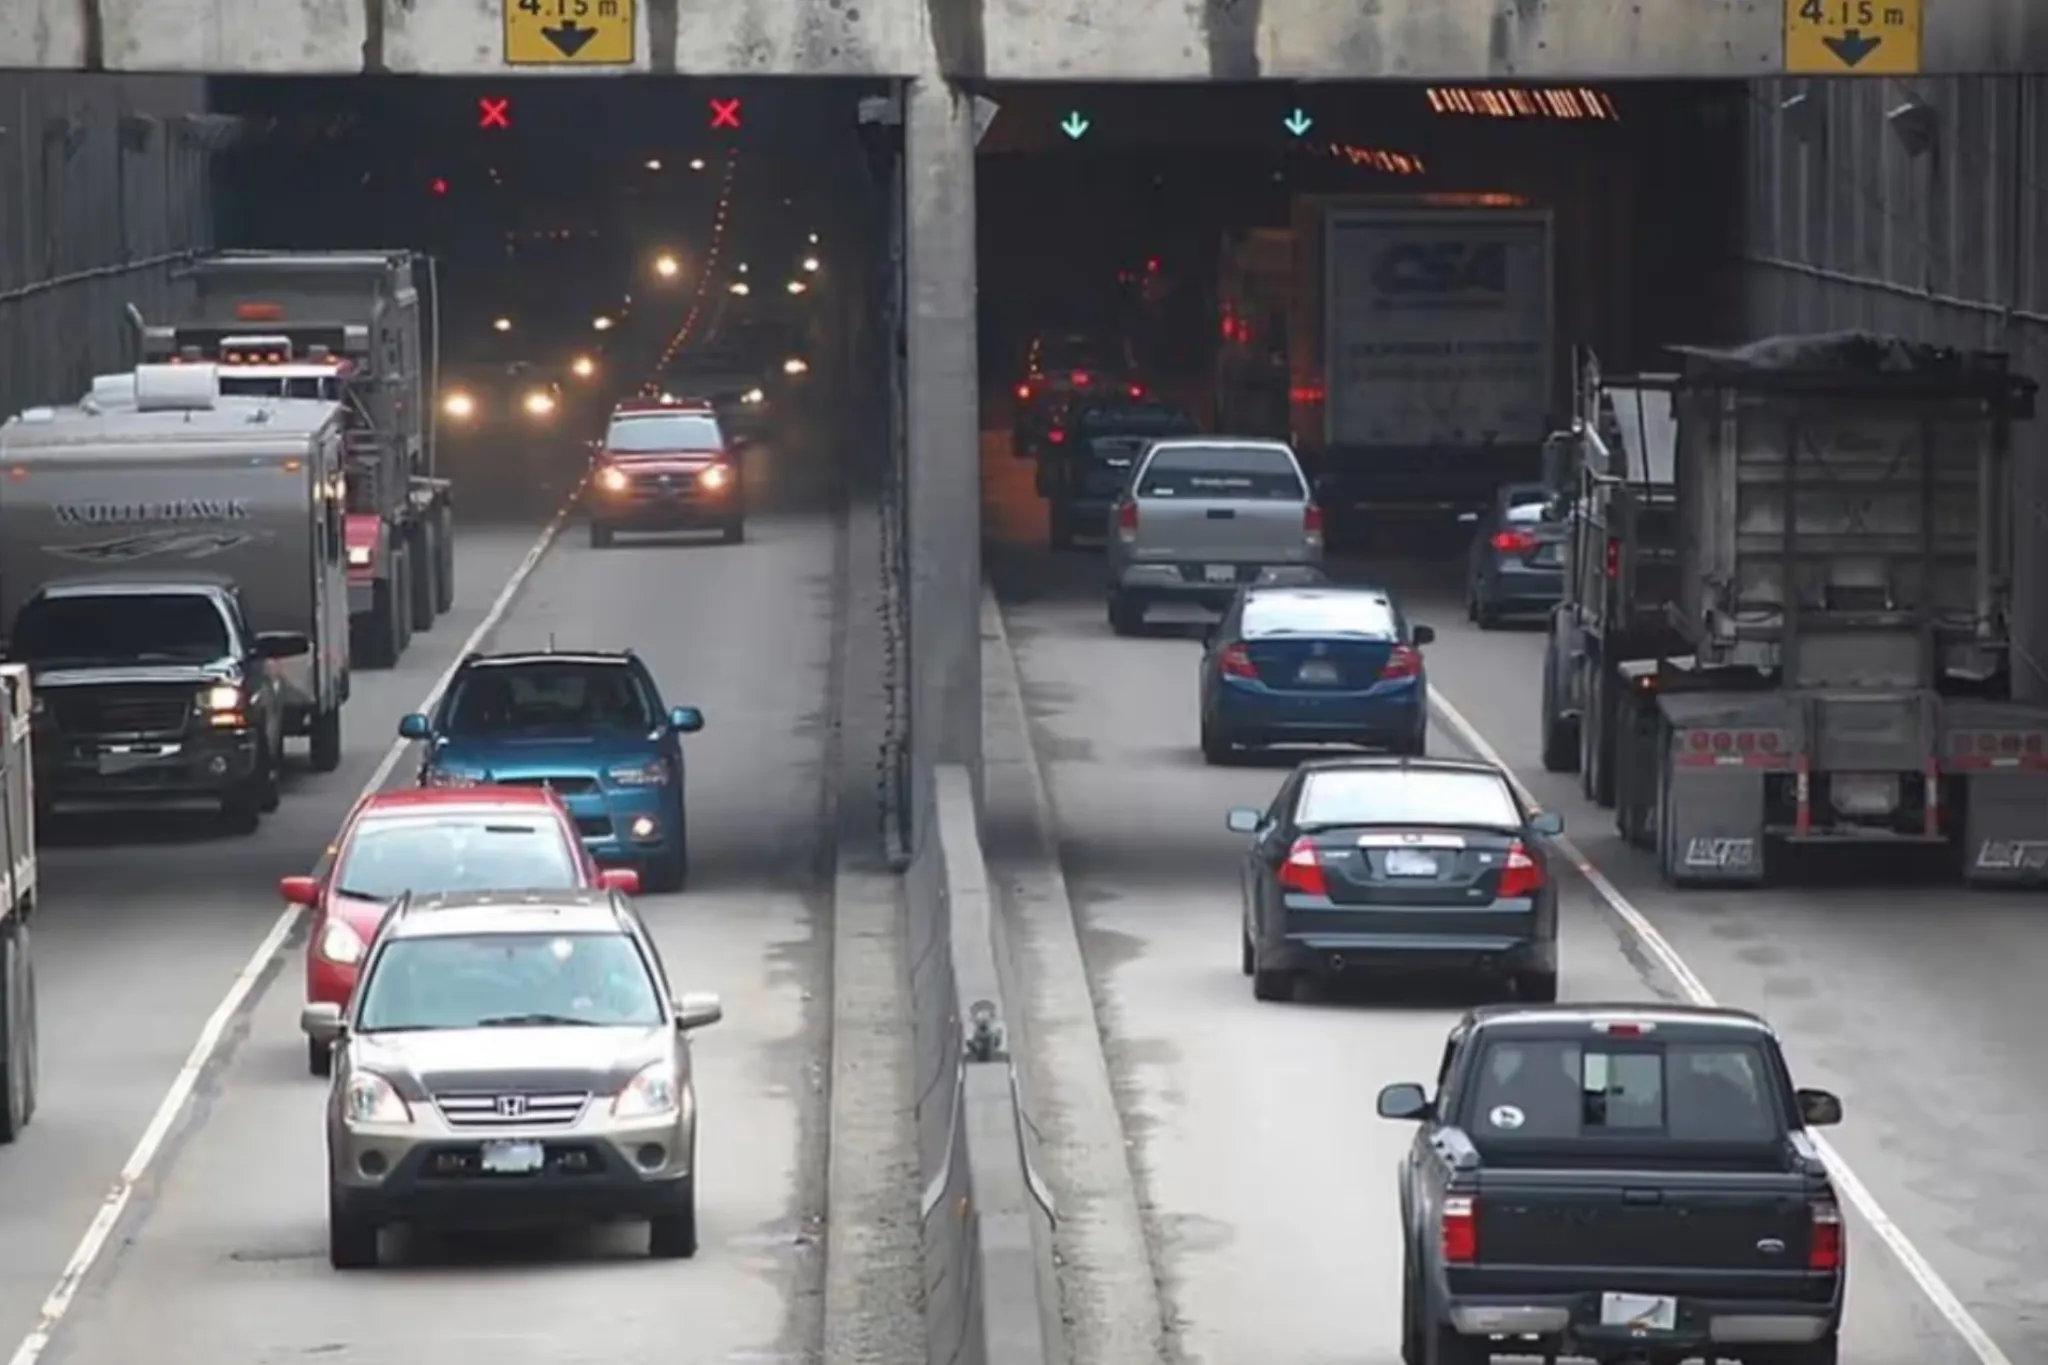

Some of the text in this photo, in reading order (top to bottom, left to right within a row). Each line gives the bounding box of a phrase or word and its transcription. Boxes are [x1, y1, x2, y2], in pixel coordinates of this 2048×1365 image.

[518, 0, 618, 16] 4.15 m
[1799, 0, 1904, 26] 4.15 m
